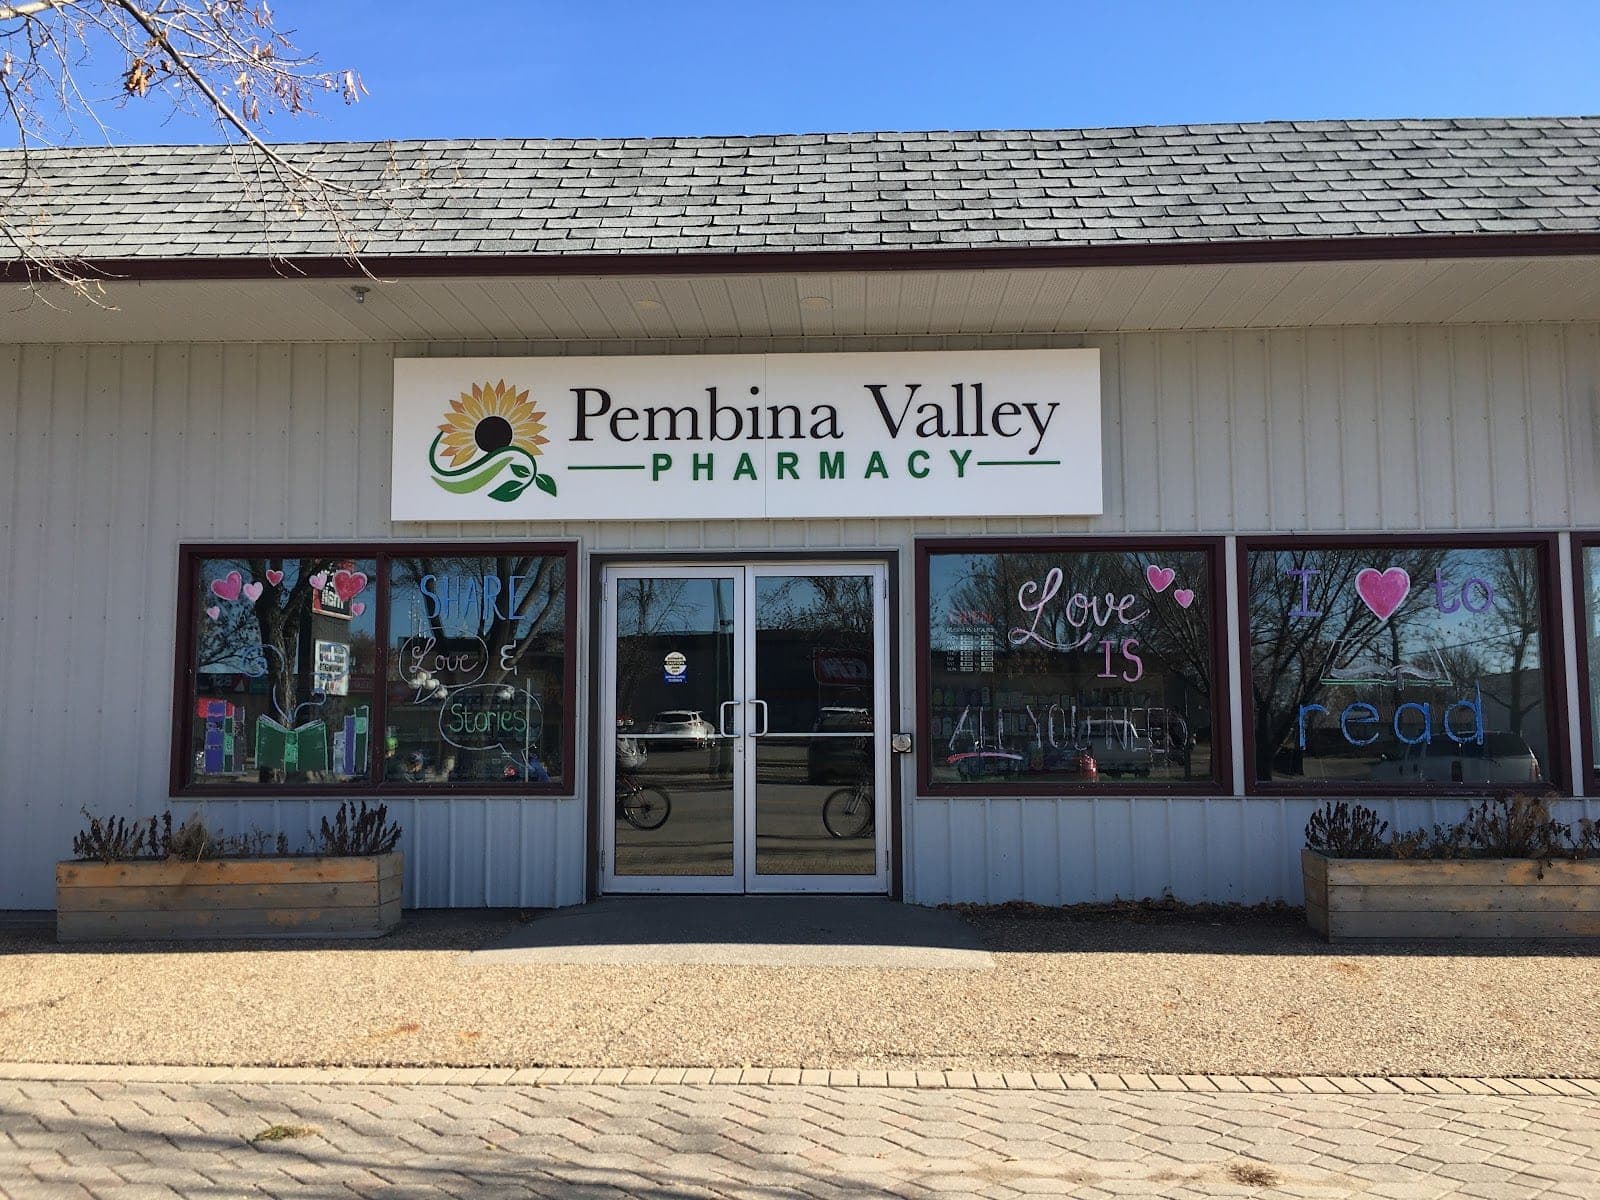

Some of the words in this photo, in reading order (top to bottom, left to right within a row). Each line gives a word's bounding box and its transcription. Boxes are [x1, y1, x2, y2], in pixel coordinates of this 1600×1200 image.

[568, 386, 843, 442] Pembina
[864, 383, 1061, 455] Valley
[653, 449, 974, 482] PHARMACY
[420, 574, 527, 620] SHARE
[1008, 568, 1150, 650] Love
[1287, 569, 1323, 617] I
[1431, 567, 1493, 614] to
[409, 636, 479, 674] Love
[1097, 638, 1144, 682] IS
[449, 703, 528, 733] Stories
[948, 704, 1006, 751] ALL
[1026, 703, 1092, 751] YOU
[1298, 679, 1485, 751] read
